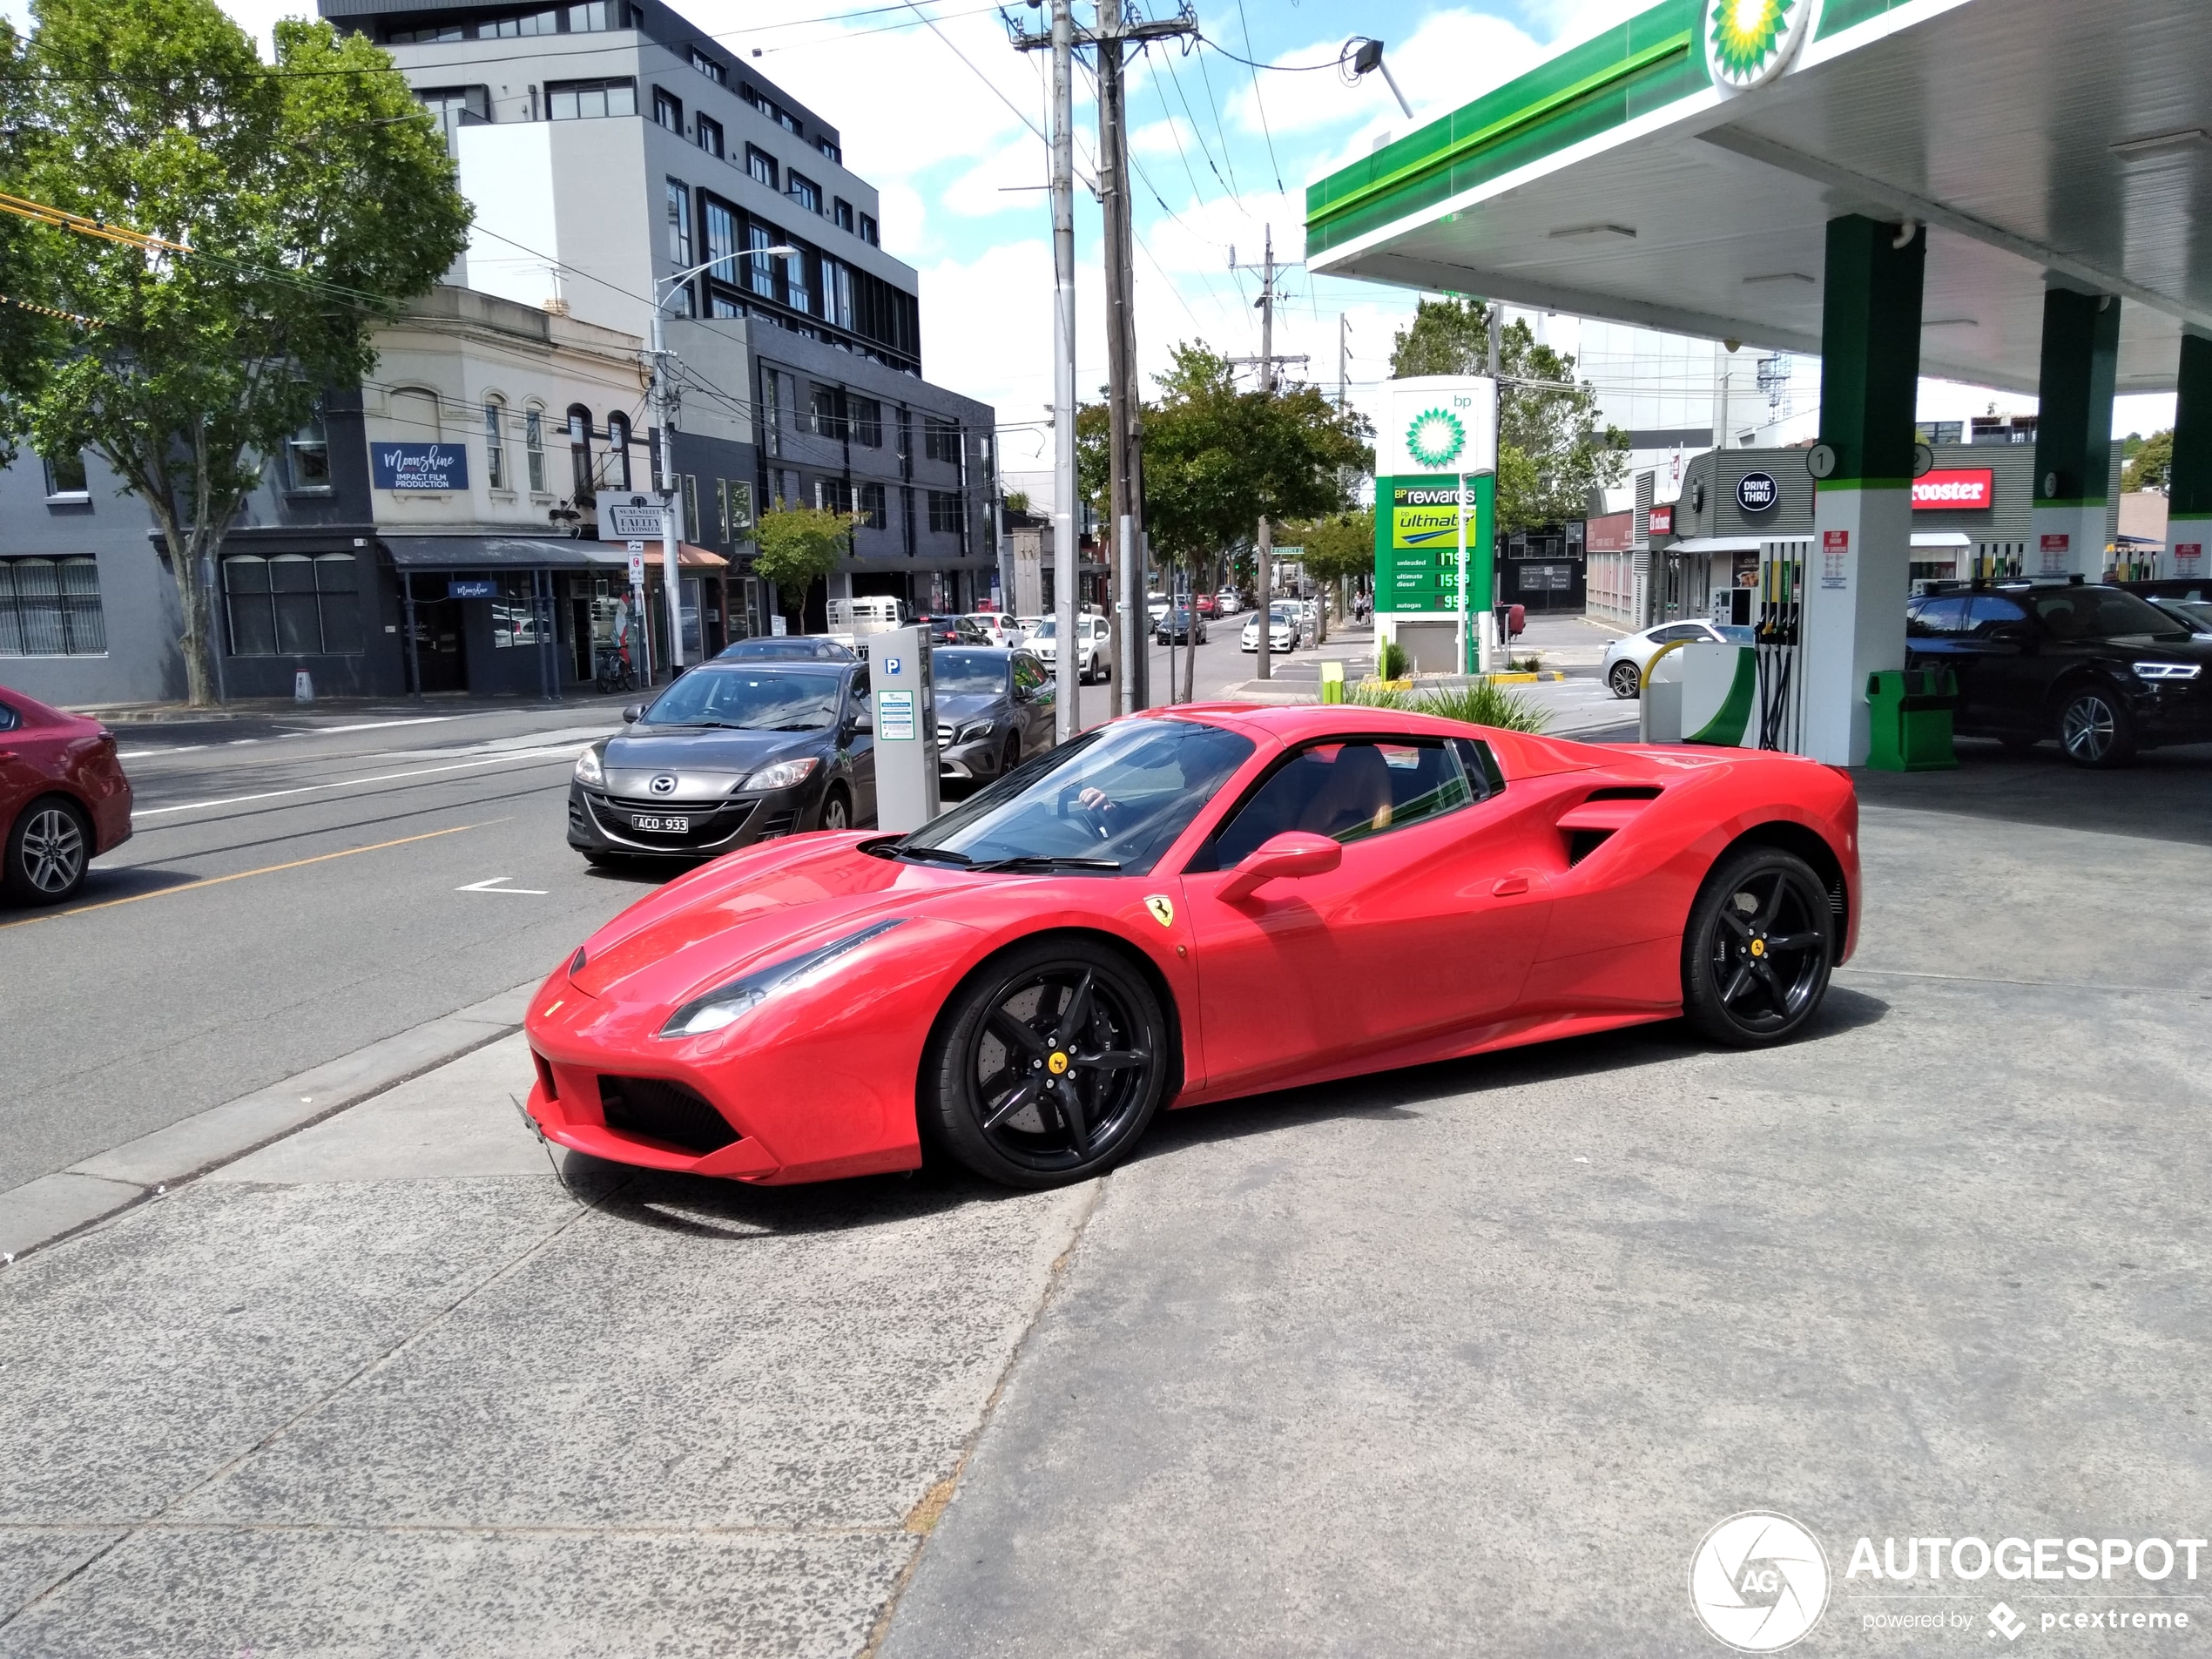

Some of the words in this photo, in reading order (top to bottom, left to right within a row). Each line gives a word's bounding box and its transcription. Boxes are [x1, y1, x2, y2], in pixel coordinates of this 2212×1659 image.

[1453, 395, 1472, 409] bp
[384, 444, 455, 472] Moonshine
[1817, 452, 1824, 470] 1
[1743, 481, 1771, 491] DRIVE
[1912, 482, 1984, 501] rooster
[1394, 489, 1407, 499] BP
[1743, 491, 1770, 502] THRU
[620, 518, 660, 527] BAKERY
[887, 659, 899, 674] P
